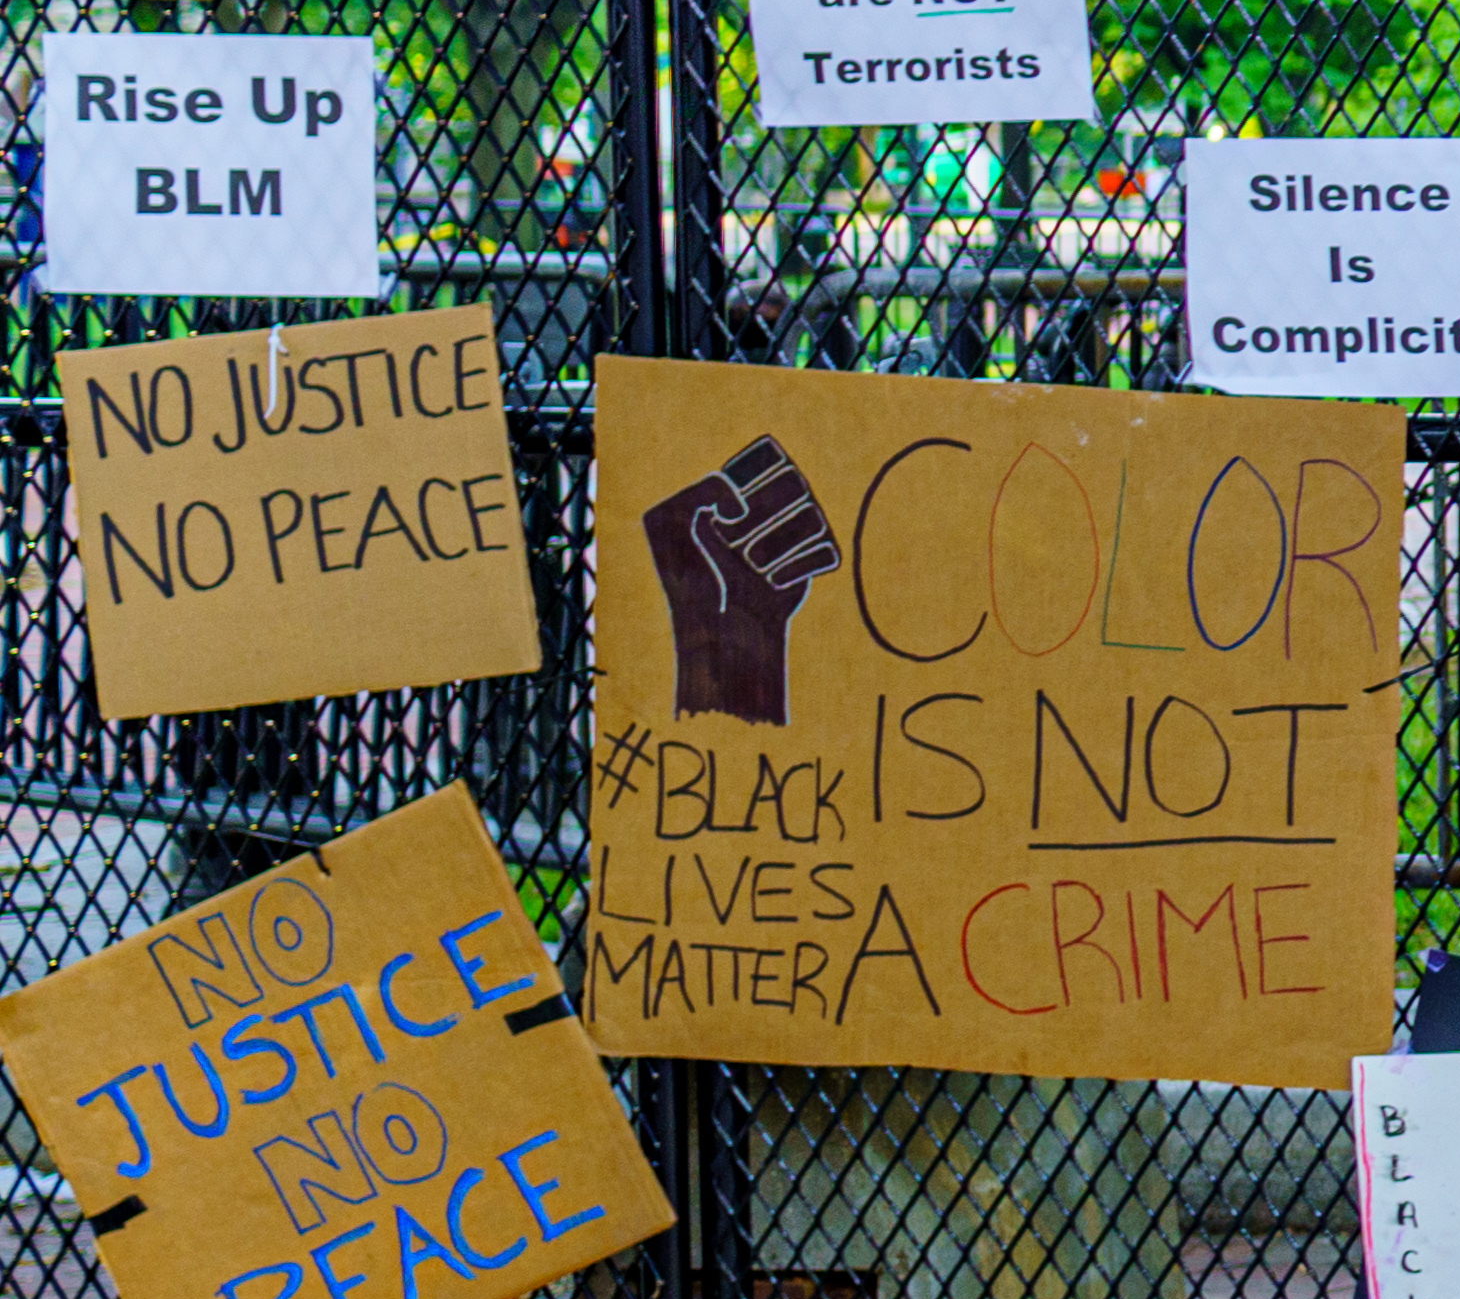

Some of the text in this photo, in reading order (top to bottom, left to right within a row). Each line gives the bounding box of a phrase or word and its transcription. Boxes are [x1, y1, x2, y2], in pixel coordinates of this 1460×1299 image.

[76, 74, 344, 136] Rise Up
[136, 168, 283, 216] BLM
[1248, 174, 1451, 214] Silence
[1329, 246, 1375, 284] Is
[86, 335, 490, 460] NO JUSTICE
[100, 473, 510, 606] NO PEACE
[852, 437, 1382, 662] COLOR
[873, 688, 1349, 830] IS NOT
[837, 879, 1327, 1024] A CRIME
